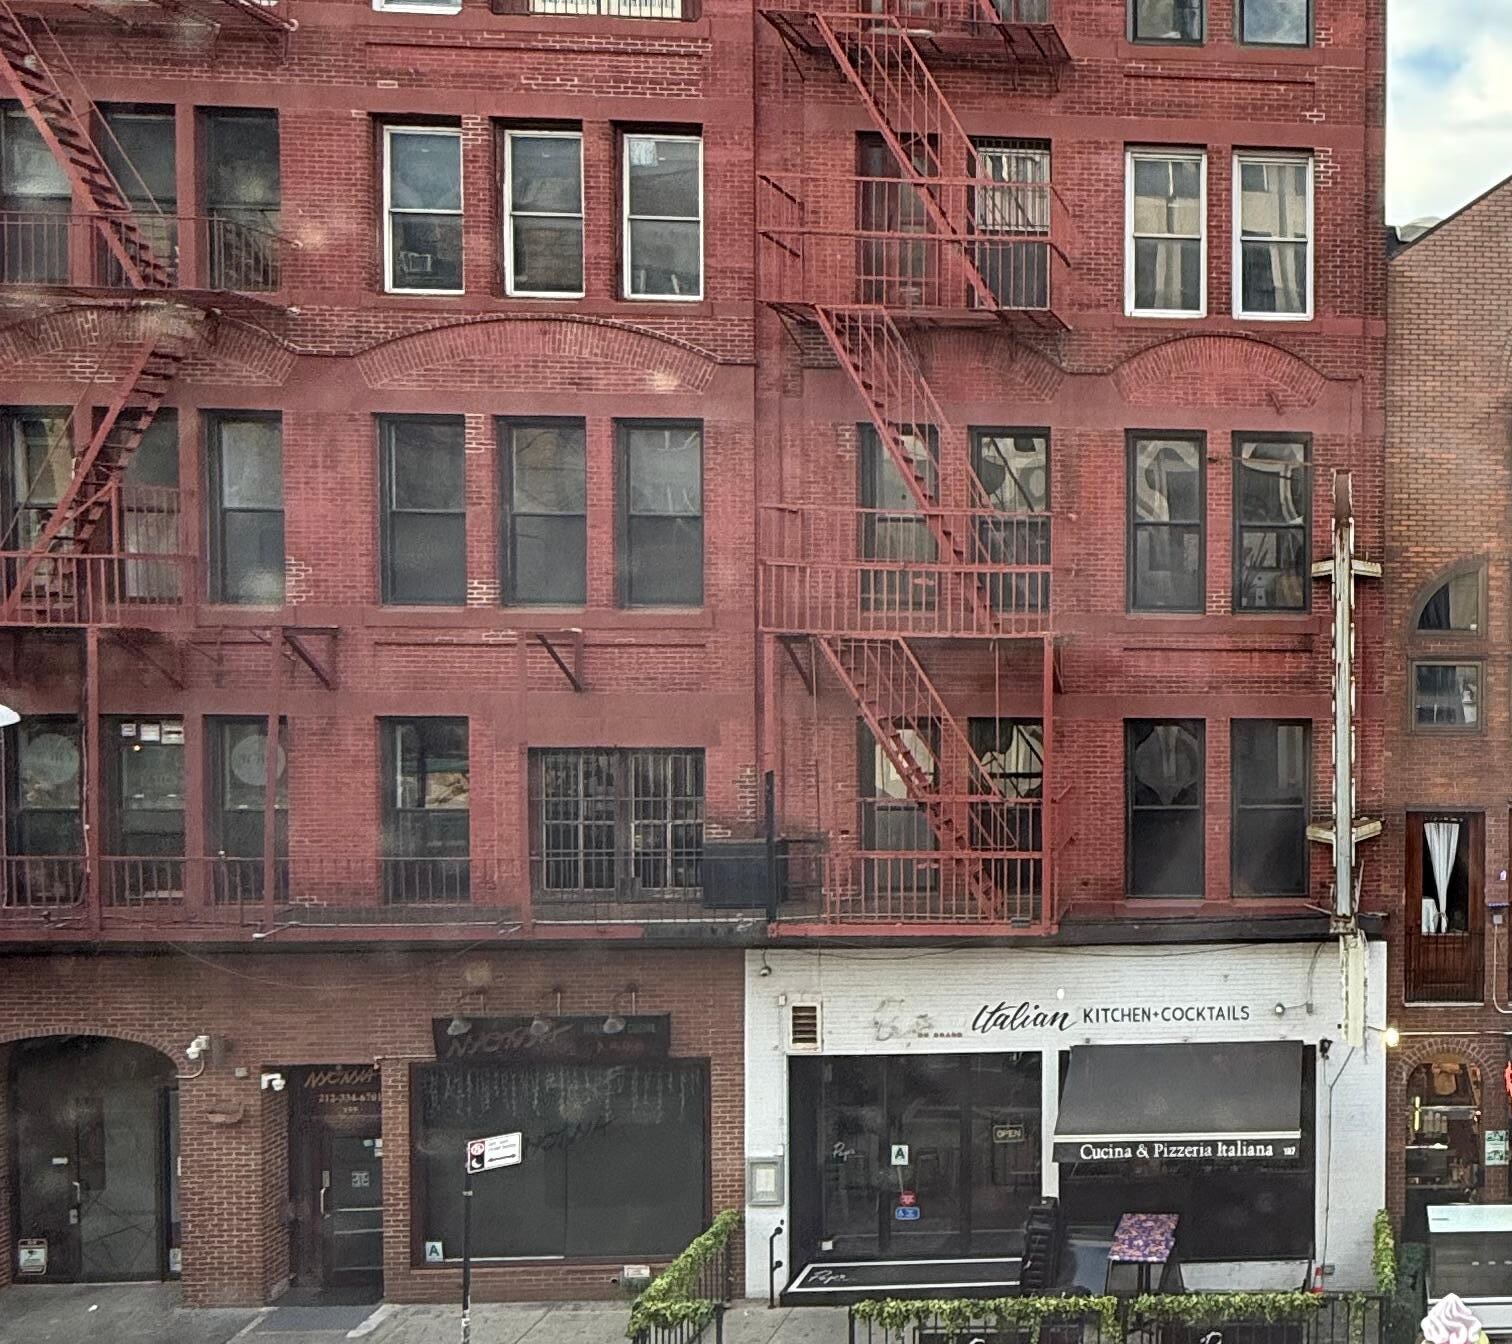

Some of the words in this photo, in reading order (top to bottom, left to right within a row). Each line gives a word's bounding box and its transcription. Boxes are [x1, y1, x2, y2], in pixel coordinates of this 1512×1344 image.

[971, 1001, 1076, 1033] Italian
[996, 1129, 1022, 1139] OPEN
[895, 1147, 905, 1159] A
[1079, 1143, 1131, 1160] Cucina
[1136, 1143, 1149, 1159] &
[1153, 1142, 1212, 1158] Pizzeria
[1217, 1140, 1273, 1157] Italiana
[428, 1244, 440, 1257] A
